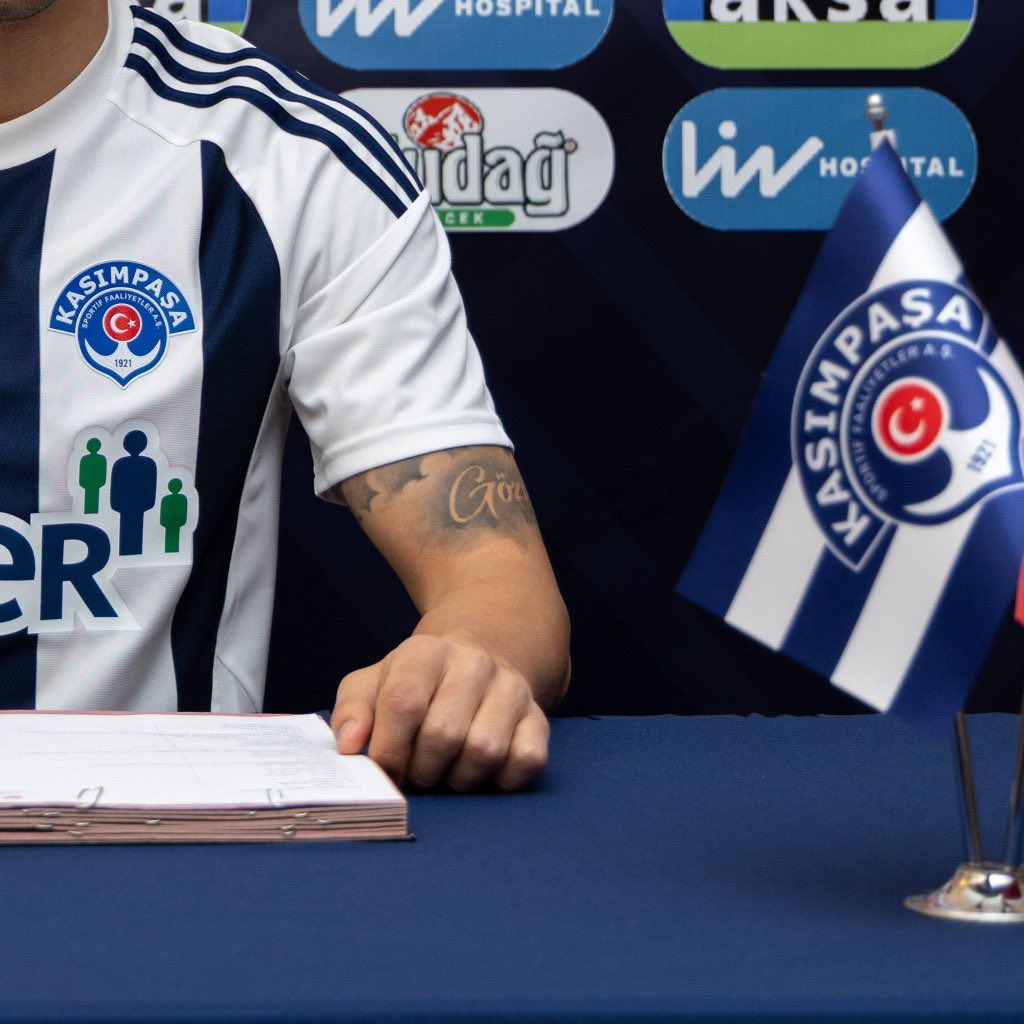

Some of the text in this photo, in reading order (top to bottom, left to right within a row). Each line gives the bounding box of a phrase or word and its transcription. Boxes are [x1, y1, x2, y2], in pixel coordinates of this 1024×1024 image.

[819, 156, 964, 177] HOITAL
[55, 265, 188, 328] KASIMPAŞA
[114, 358, 132, 368] 1921
[804, 287, 973, 548] KASIMPAŞA
